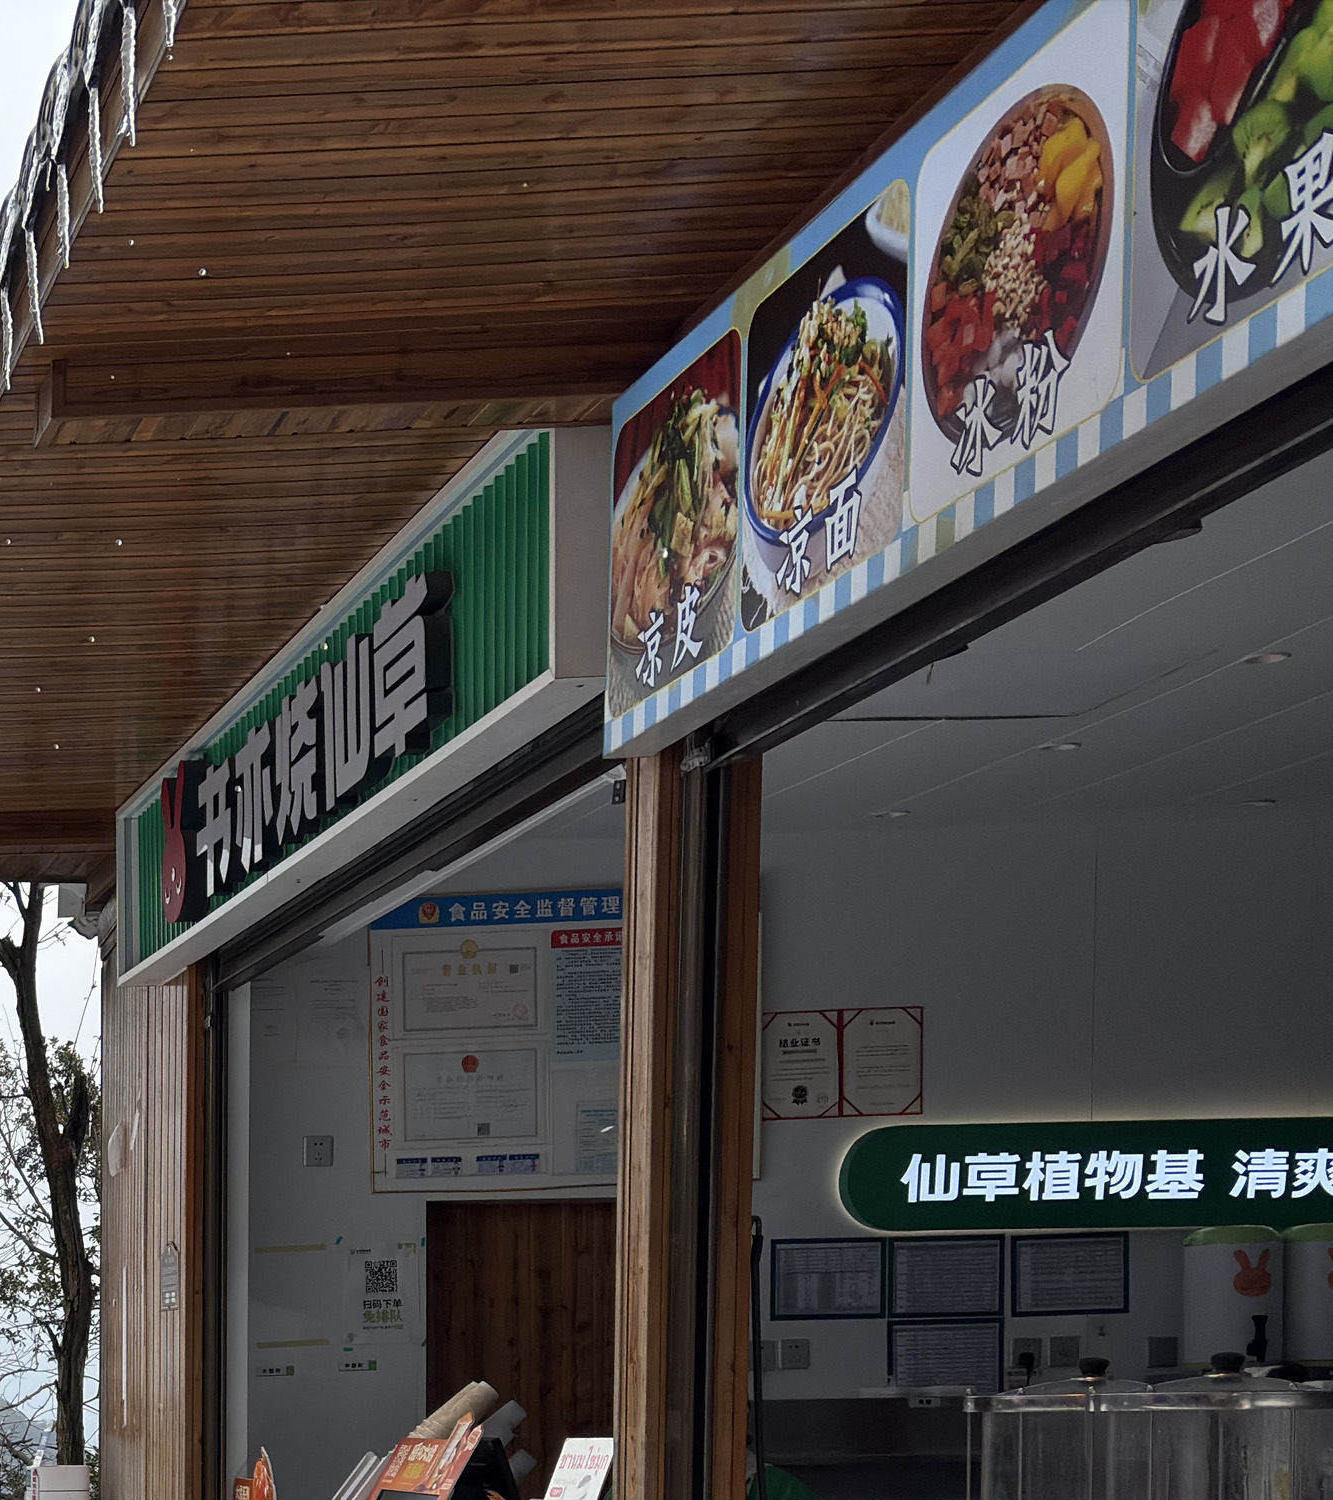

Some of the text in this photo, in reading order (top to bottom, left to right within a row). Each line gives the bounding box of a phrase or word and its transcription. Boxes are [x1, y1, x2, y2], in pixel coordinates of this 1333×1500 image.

[950, 330, 1071, 476] 冰粉
[775, 468, 862, 594] 凉面
[635, 584, 704, 688] 凉皮
[196, 573, 431, 898] 书亦烧仙草
[448, 896, 621, 922] 食品安全监督管理
[901, 1148, 1333, 1203] 仙草植物基 清爽
